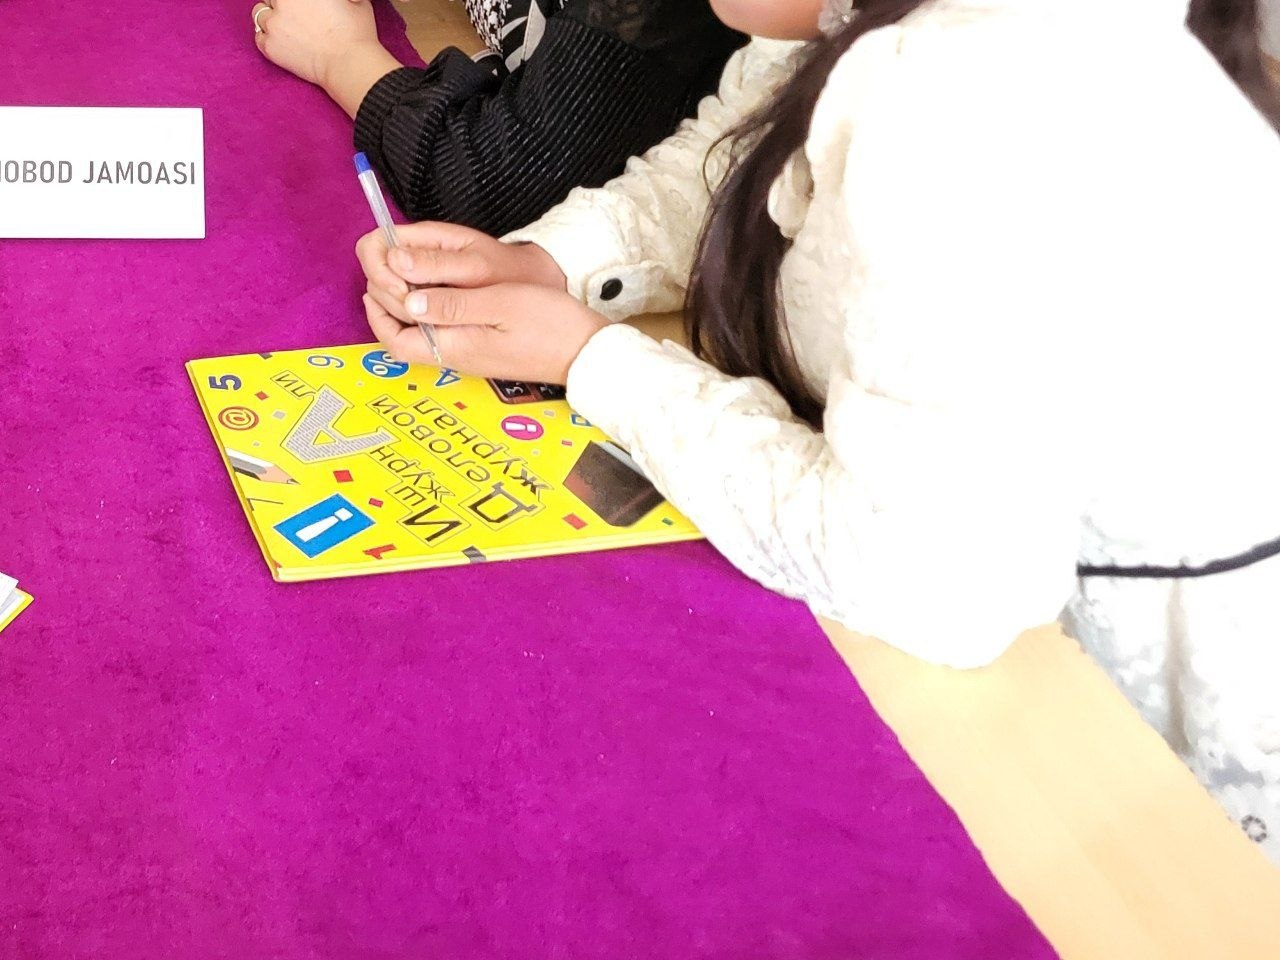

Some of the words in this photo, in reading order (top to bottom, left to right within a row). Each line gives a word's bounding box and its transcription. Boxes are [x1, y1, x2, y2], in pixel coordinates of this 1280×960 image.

[83, 160, 195, 185] JAMOASI
[209, 374, 242, 391] 5
[372, 396, 539, 524] Деловой
[413, 397, 551, 495] журнал
[392, 485, 463, 543] Иш
